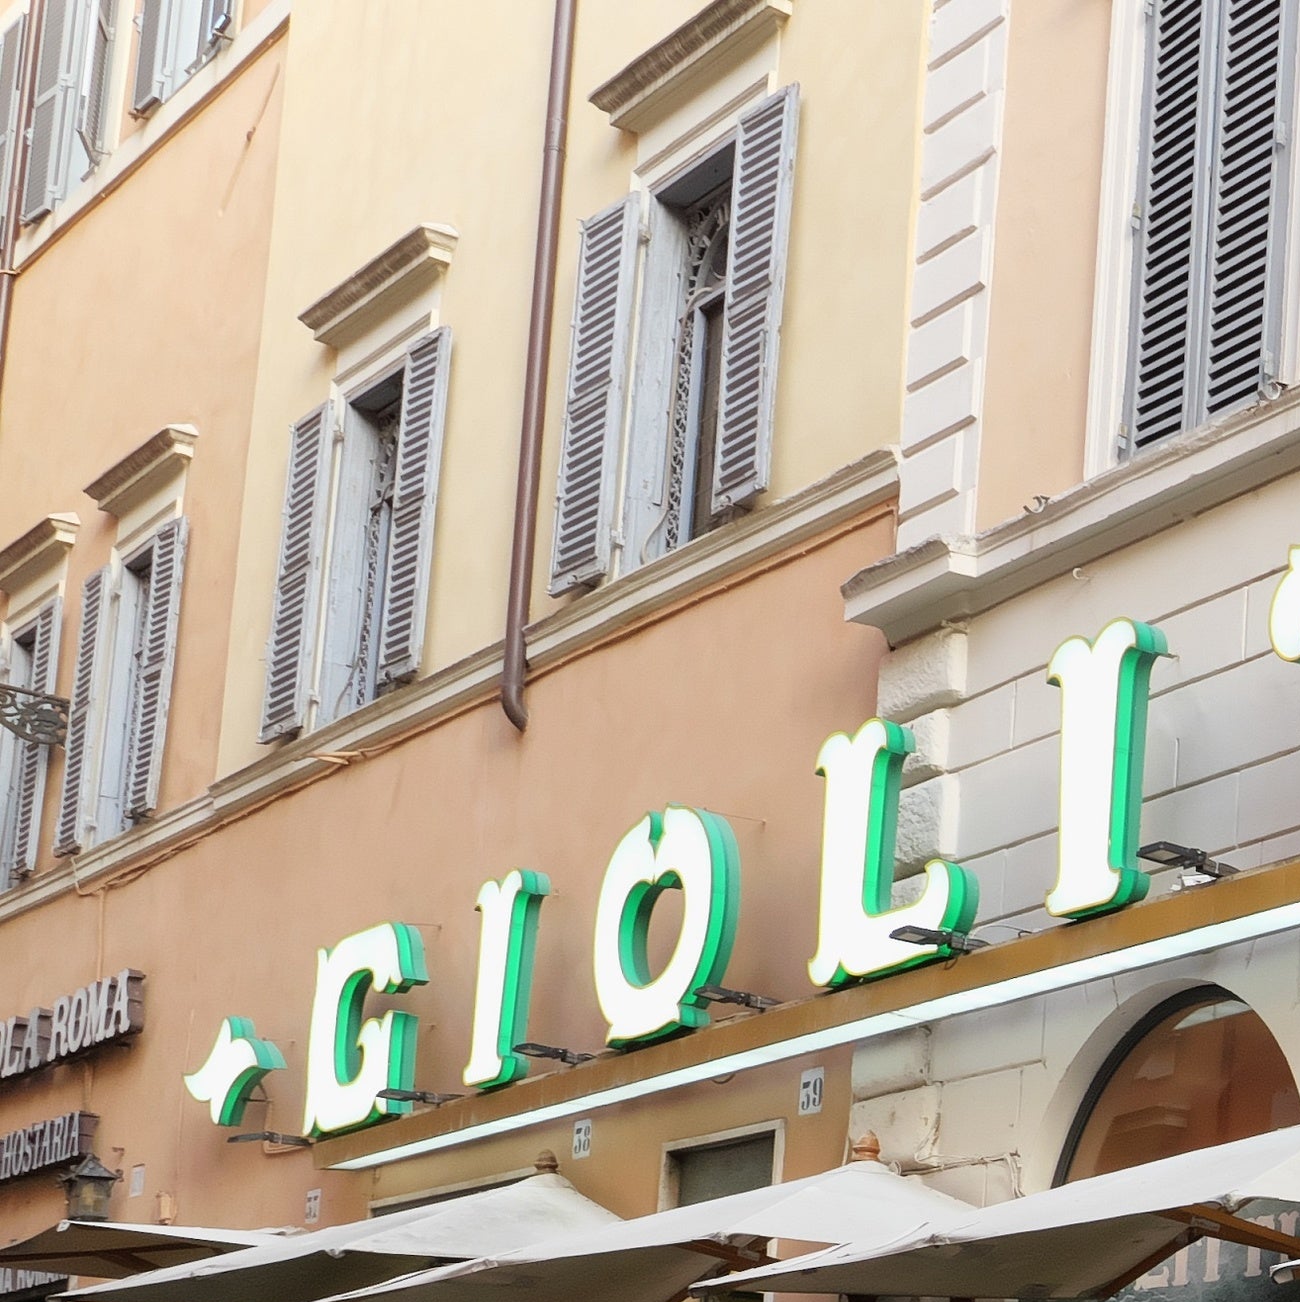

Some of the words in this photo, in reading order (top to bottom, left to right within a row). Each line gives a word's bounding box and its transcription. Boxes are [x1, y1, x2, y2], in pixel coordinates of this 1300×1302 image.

[47, 967, 131, 1062] ROMA
[801, 1077, 823, 1111] 39
[0, 1110, 80, 1180] HOSTARIA
[574, 1125, 591, 1154] 38
